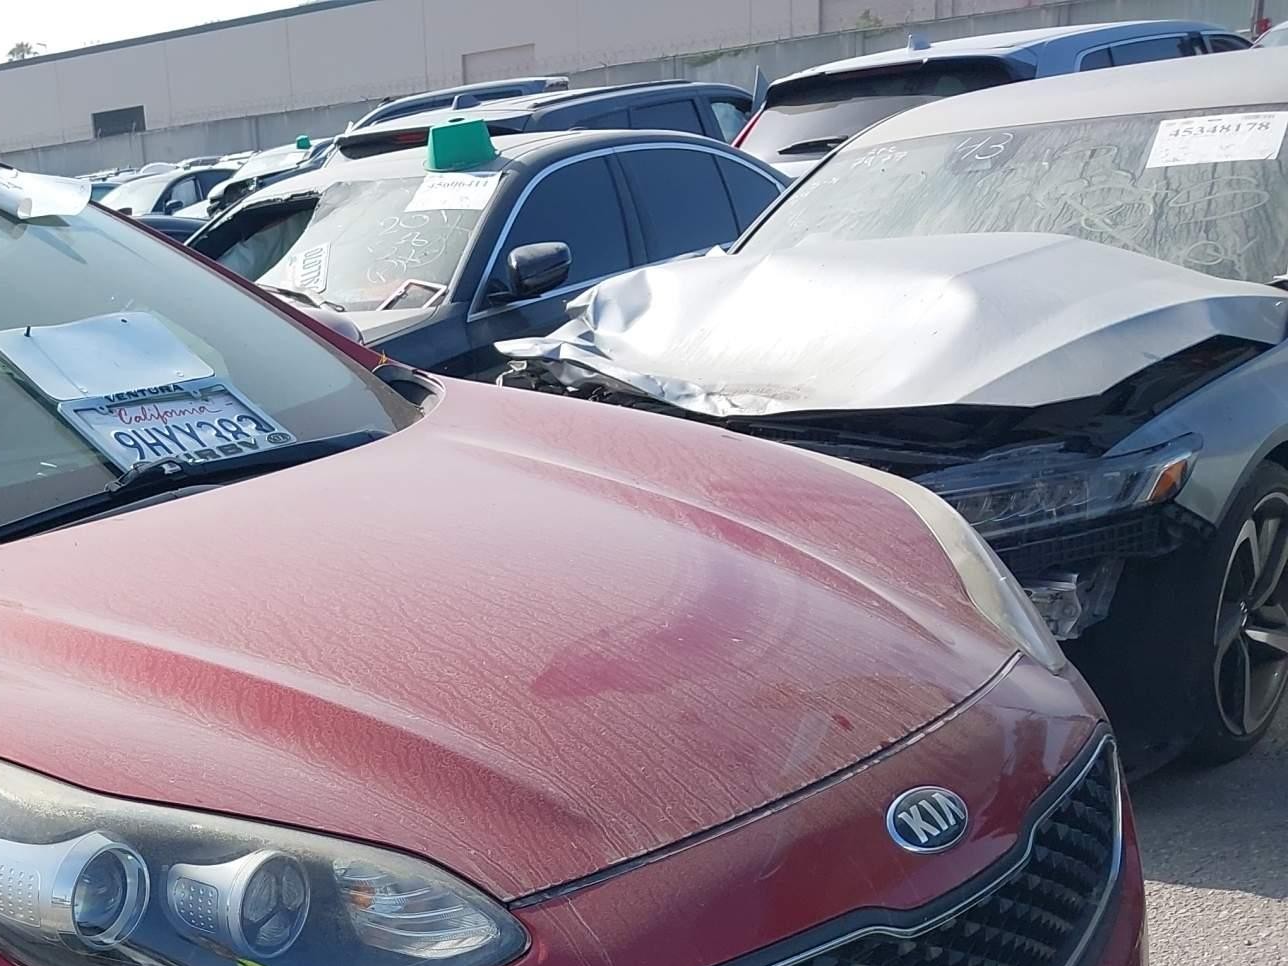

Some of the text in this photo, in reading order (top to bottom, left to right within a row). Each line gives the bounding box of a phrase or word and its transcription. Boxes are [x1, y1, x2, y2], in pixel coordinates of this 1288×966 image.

[104, 384, 184, 402] VENTURA
[116, 402, 221, 425] California
[897, 792, 966, 844] KIA
